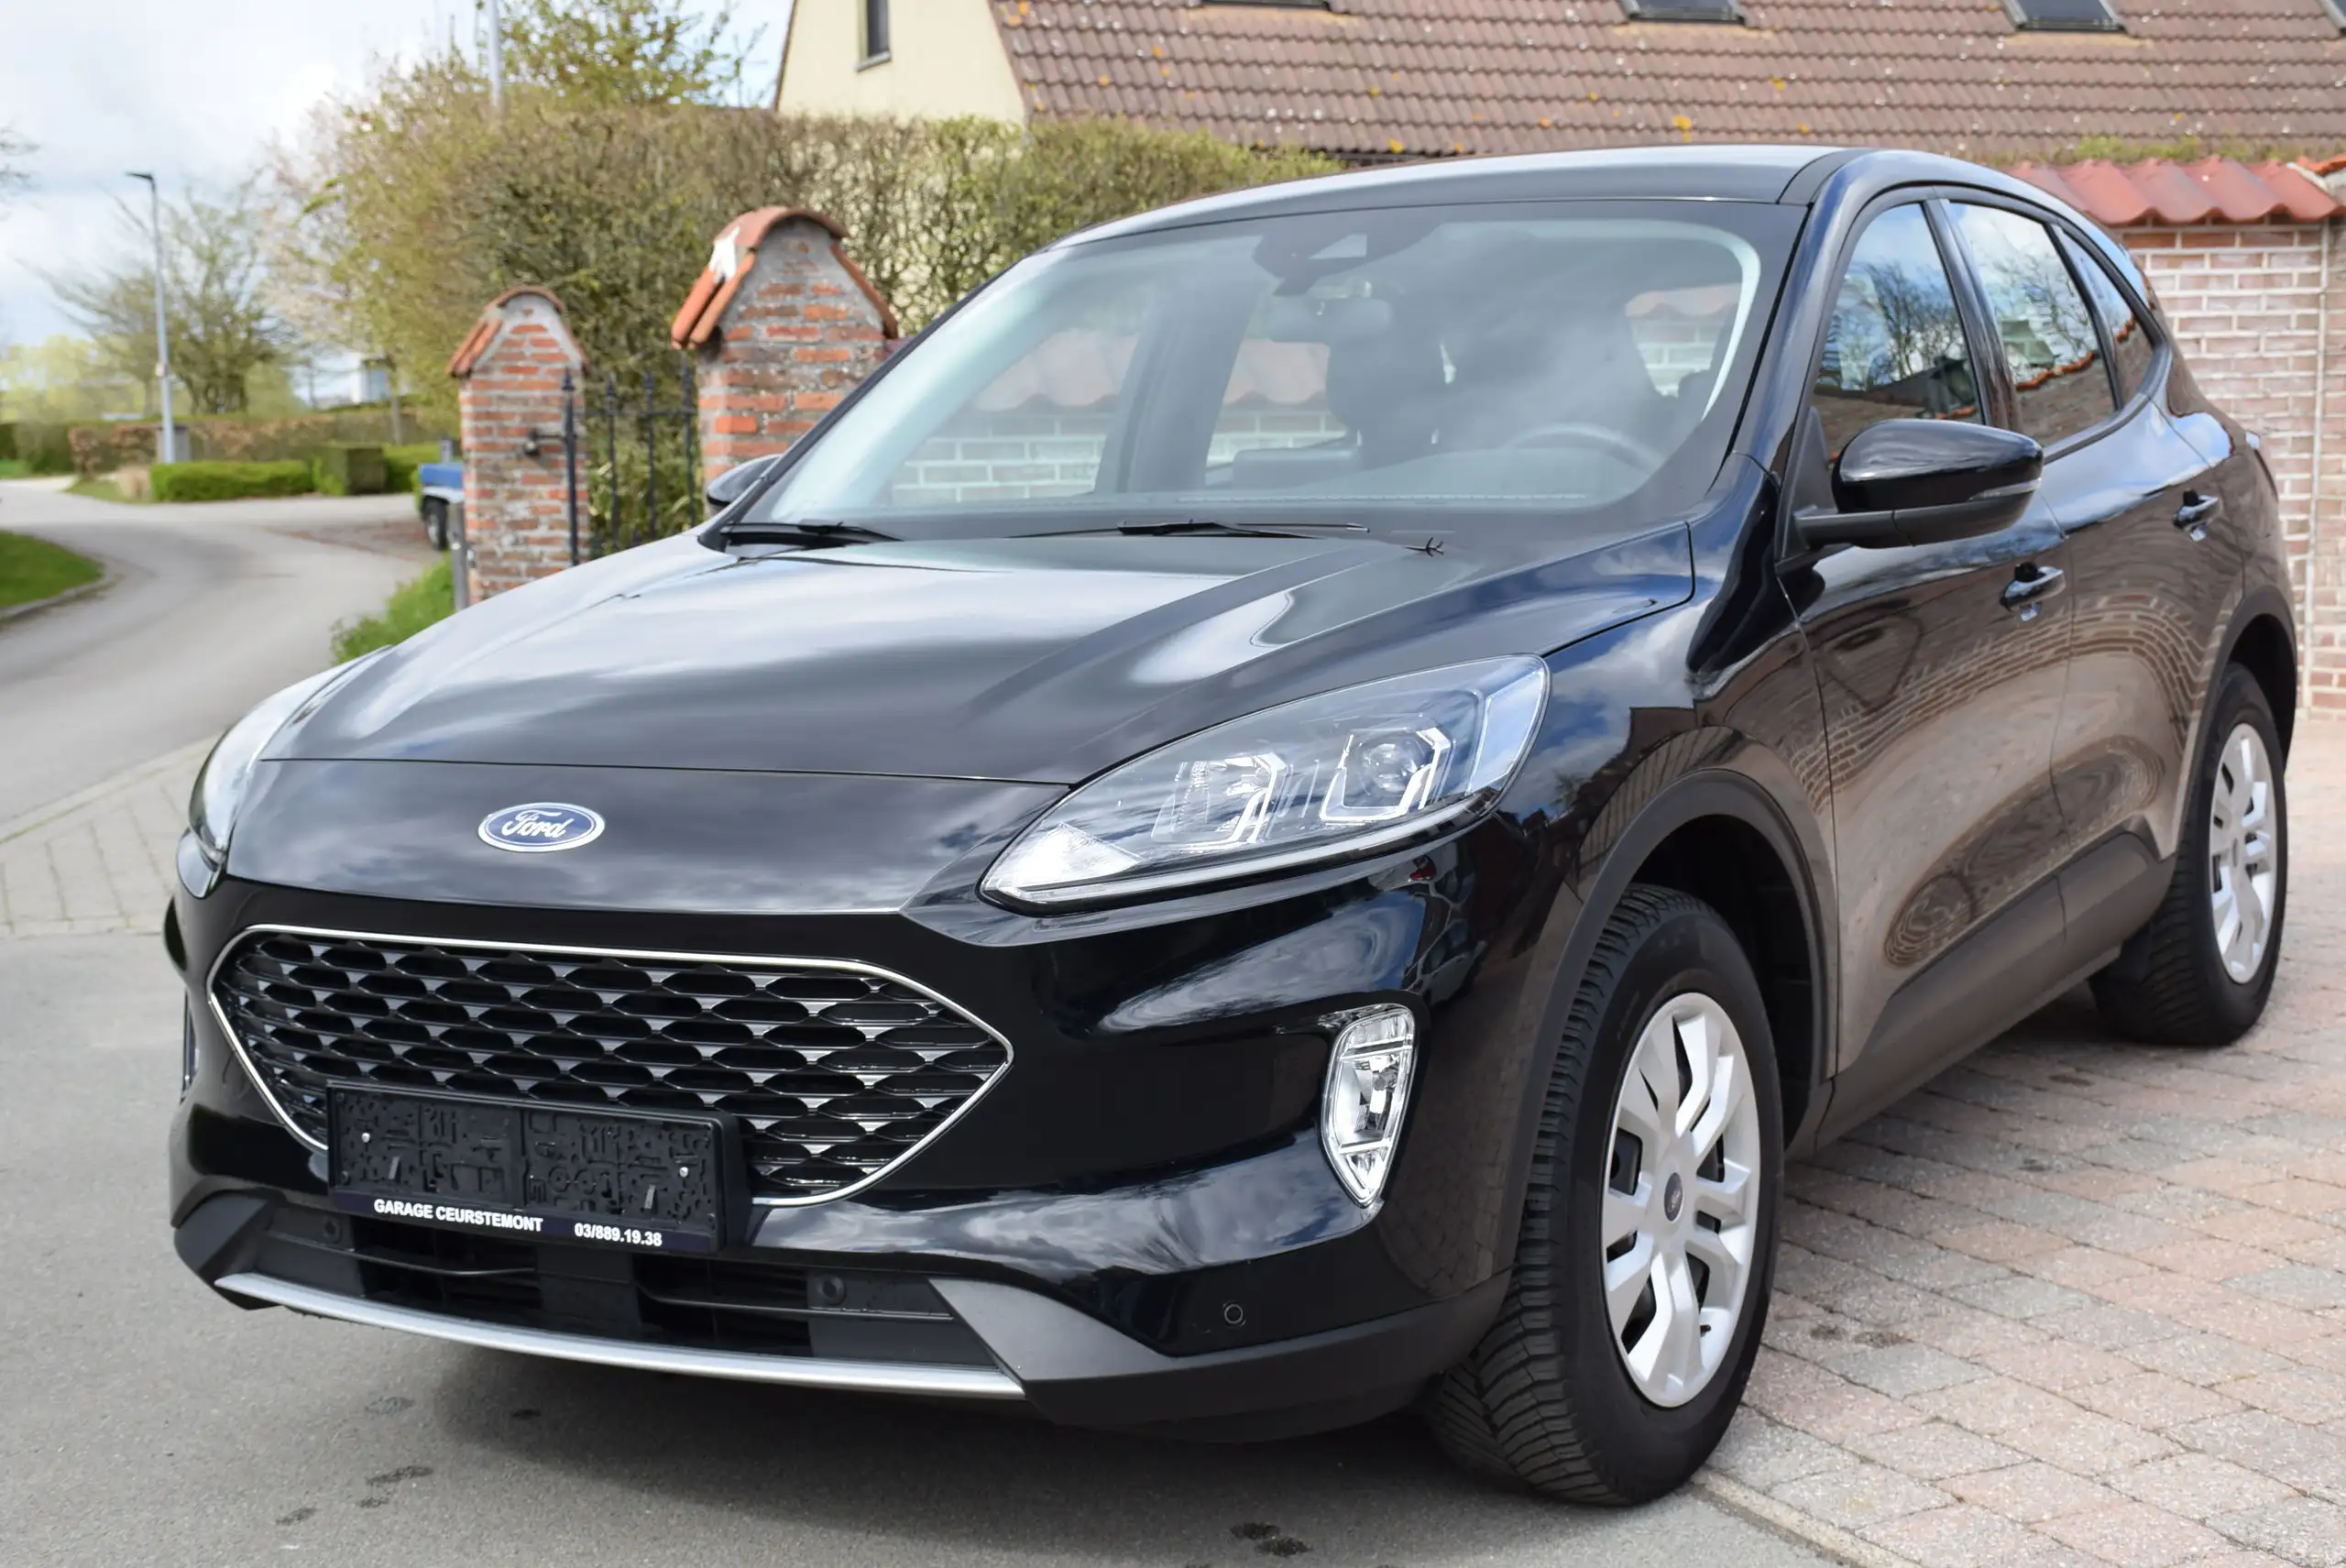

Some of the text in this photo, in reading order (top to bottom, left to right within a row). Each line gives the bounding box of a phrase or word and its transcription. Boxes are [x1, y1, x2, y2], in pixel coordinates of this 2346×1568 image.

[501, 809, 574, 839] Ford
[374, 1199, 663, 1246] GARAGE CEURSTEMONT 03/889.19.38
